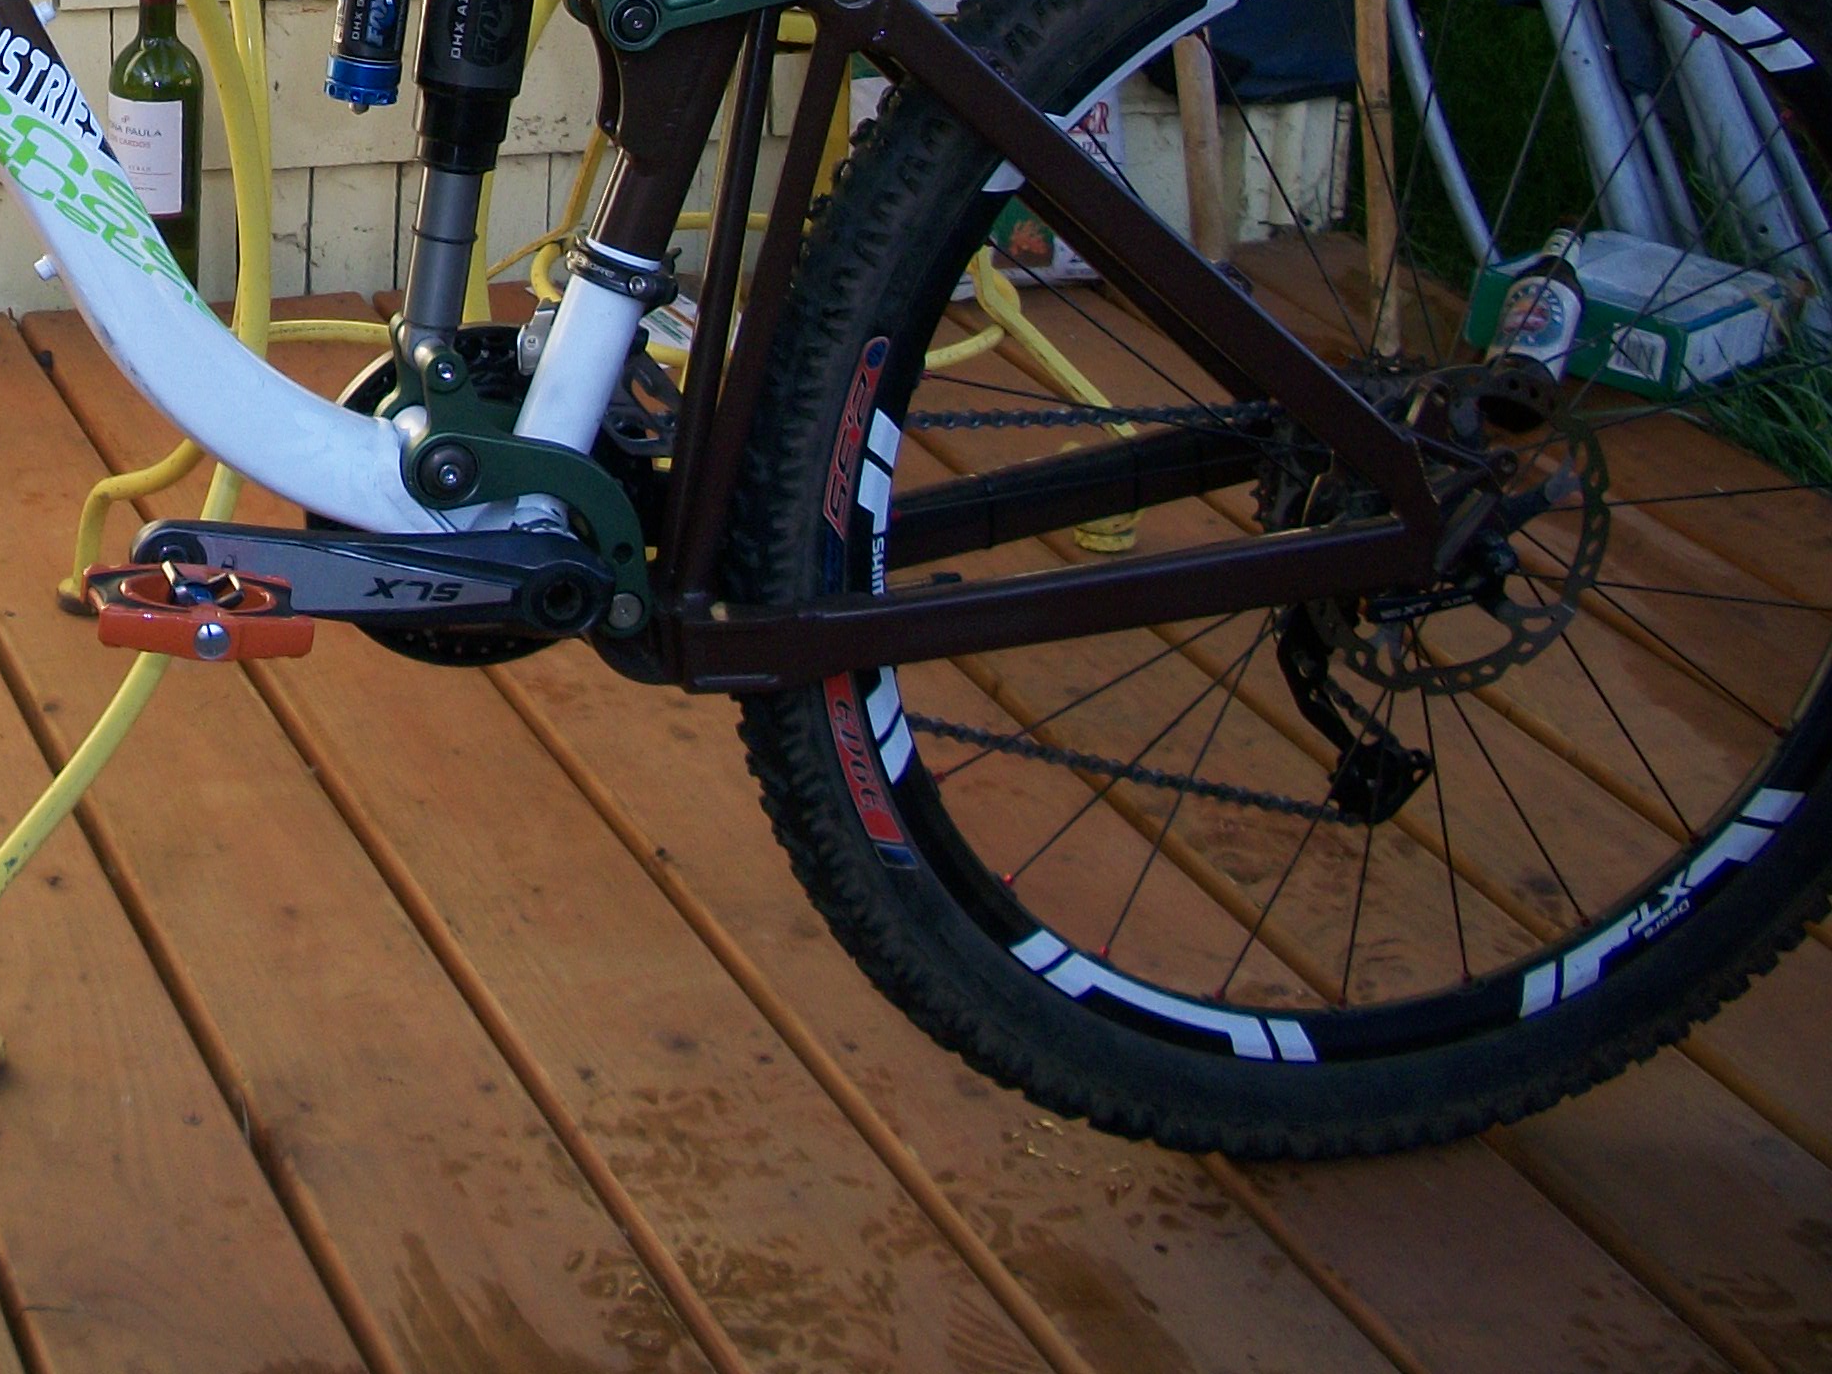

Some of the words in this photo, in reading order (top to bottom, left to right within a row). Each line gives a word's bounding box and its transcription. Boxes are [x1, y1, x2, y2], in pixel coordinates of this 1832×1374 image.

[449, 20, 467, 60] DHX
[126, 127, 163, 138] PAULA
[363, 577, 464, 602] SLX
[1627, 876, 1692, 934] XT
